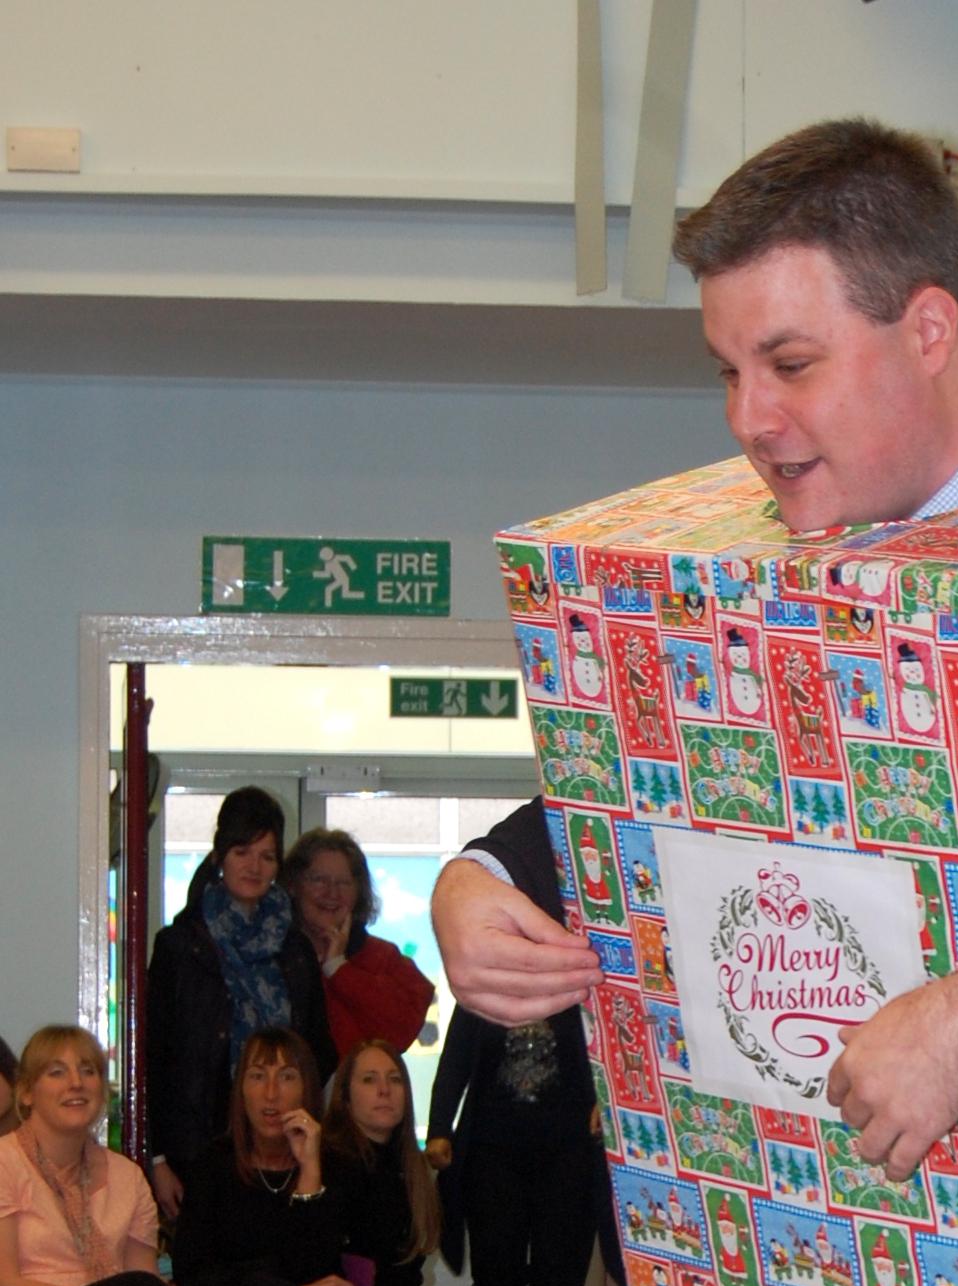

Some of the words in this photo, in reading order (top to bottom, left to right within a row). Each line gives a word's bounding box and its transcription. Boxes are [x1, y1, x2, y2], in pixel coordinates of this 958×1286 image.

[377, 553, 438, 576] FIRE
[377, 582, 438, 604] EXIT
[401, 682, 429, 696] Fire
[401, 700, 428, 712] exit
[736, 932, 840, 982] Merry
[718, 964, 881, 1012] Christmas
